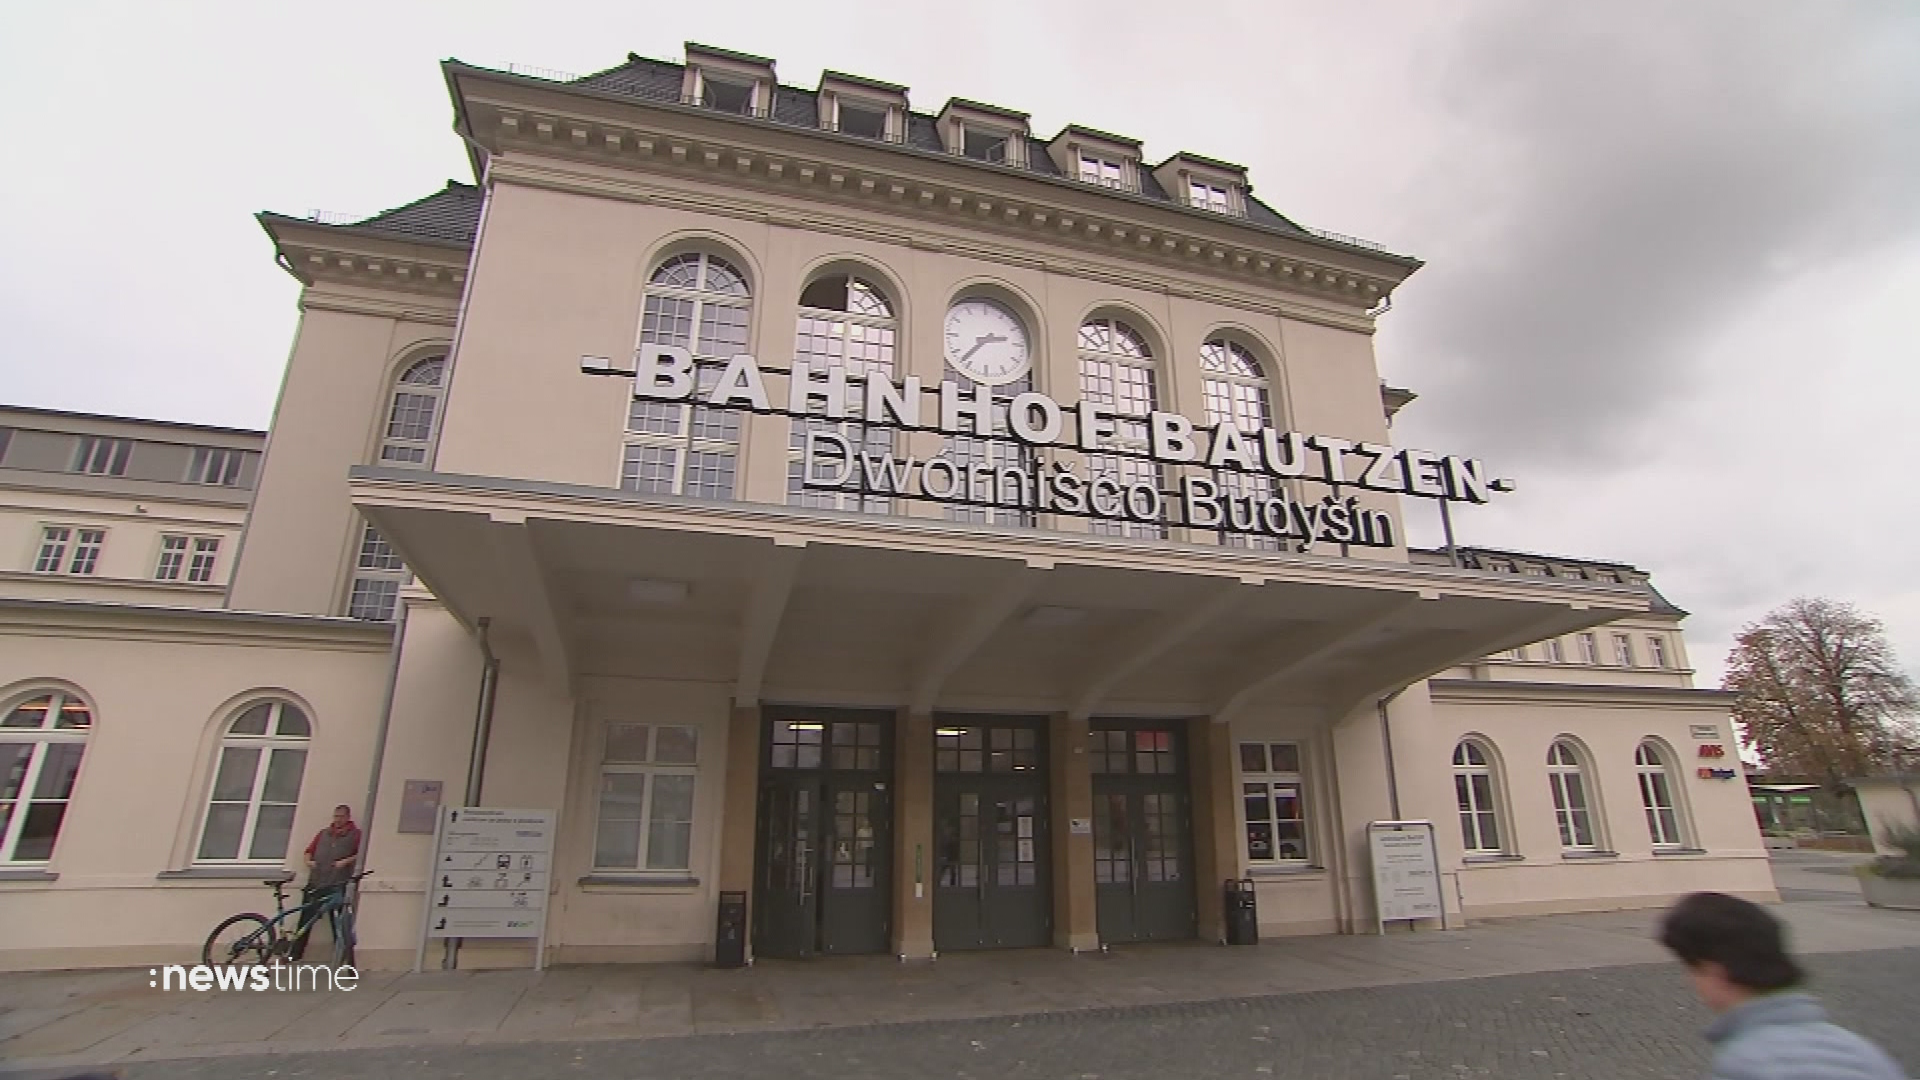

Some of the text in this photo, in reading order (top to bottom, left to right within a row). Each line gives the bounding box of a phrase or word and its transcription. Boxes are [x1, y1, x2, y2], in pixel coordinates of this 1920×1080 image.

[634, 342, 1119, 451] BAHNHOF
[1150, 410, 1490, 504] BAUTZEN
[1184, 473, 1397, 553] Budyšin
